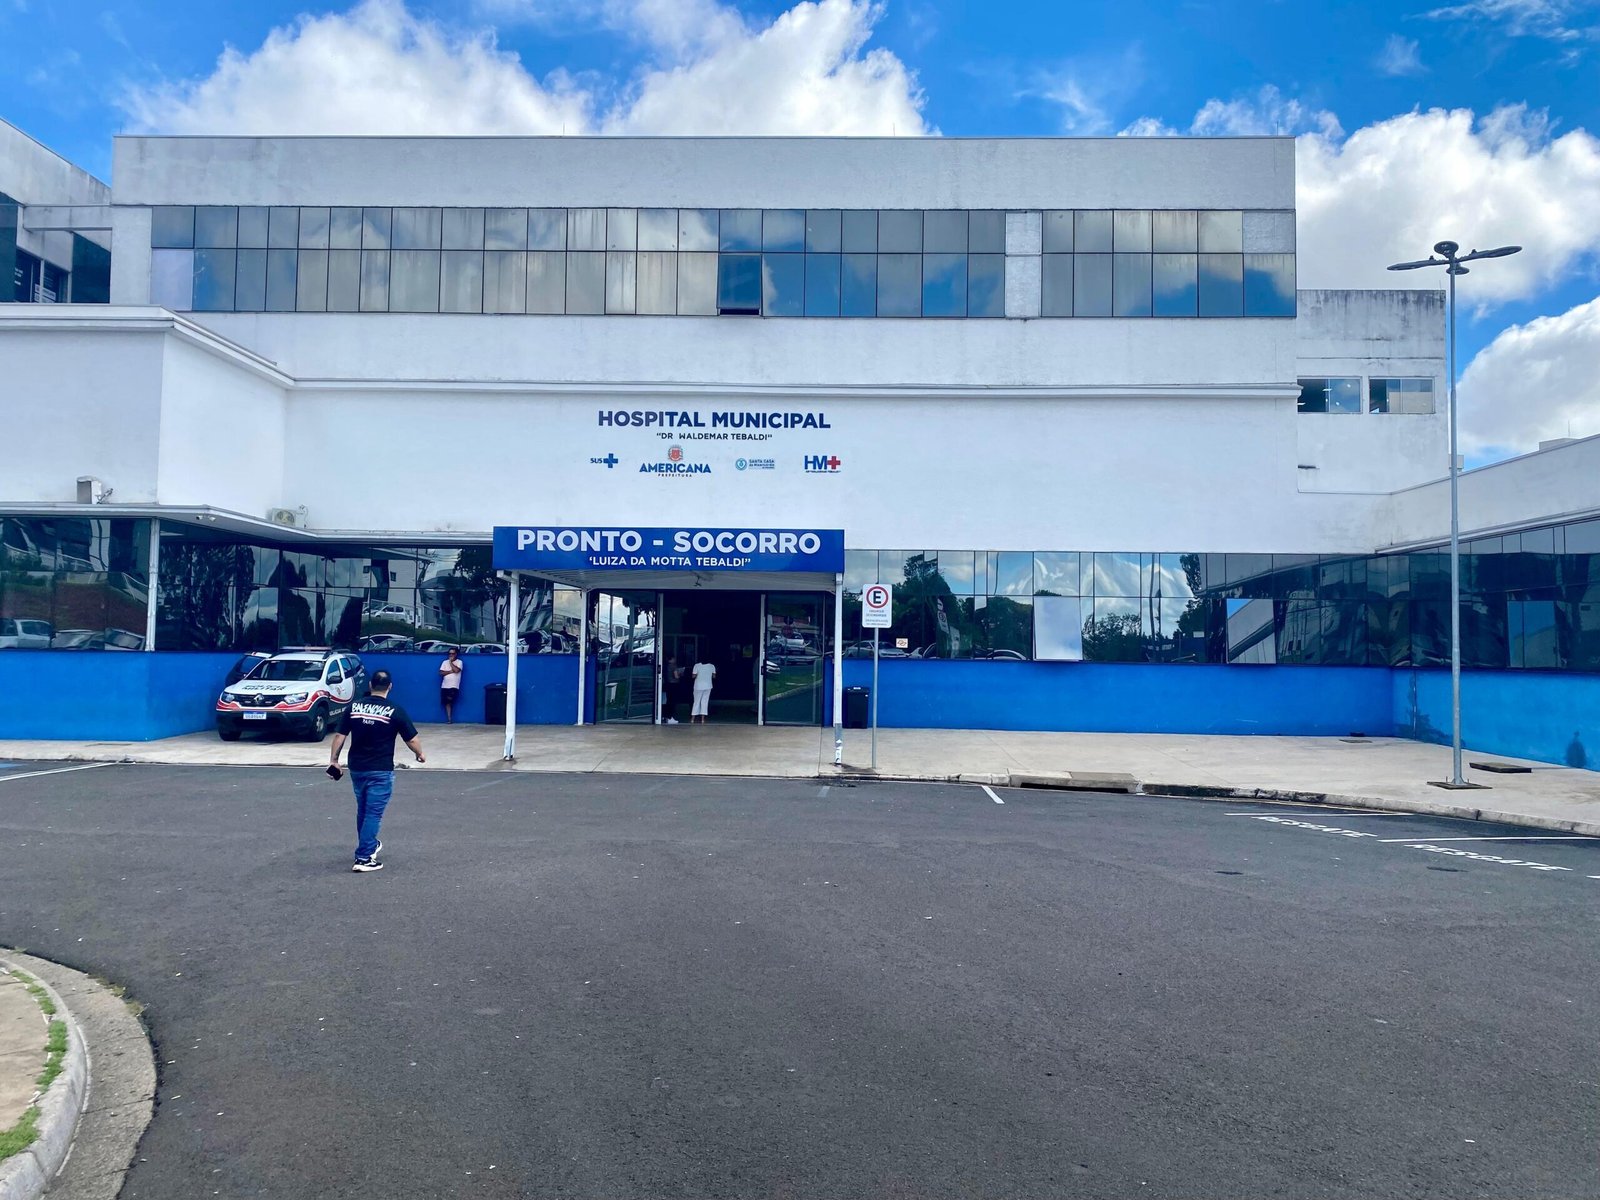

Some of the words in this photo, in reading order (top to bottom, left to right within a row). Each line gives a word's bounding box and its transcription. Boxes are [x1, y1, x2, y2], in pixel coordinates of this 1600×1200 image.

[598, 410, 706, 428] HOSPITAL
[712, 412, 831, 429] MUNICIPAL
[679, 433, 729, 441] WALDEMAR
[639, 462, 711, 474] AMERICANA
[517, 529, 643, 552] PRONTO
[673, 531, 821, 554] SOCORRO
[630, 557, 646, 566] DA
[650, 557, 691, 566] MOTTA
[873, 591, 882, 604] E
[1403, 844, 1574, 871] RESGATE
